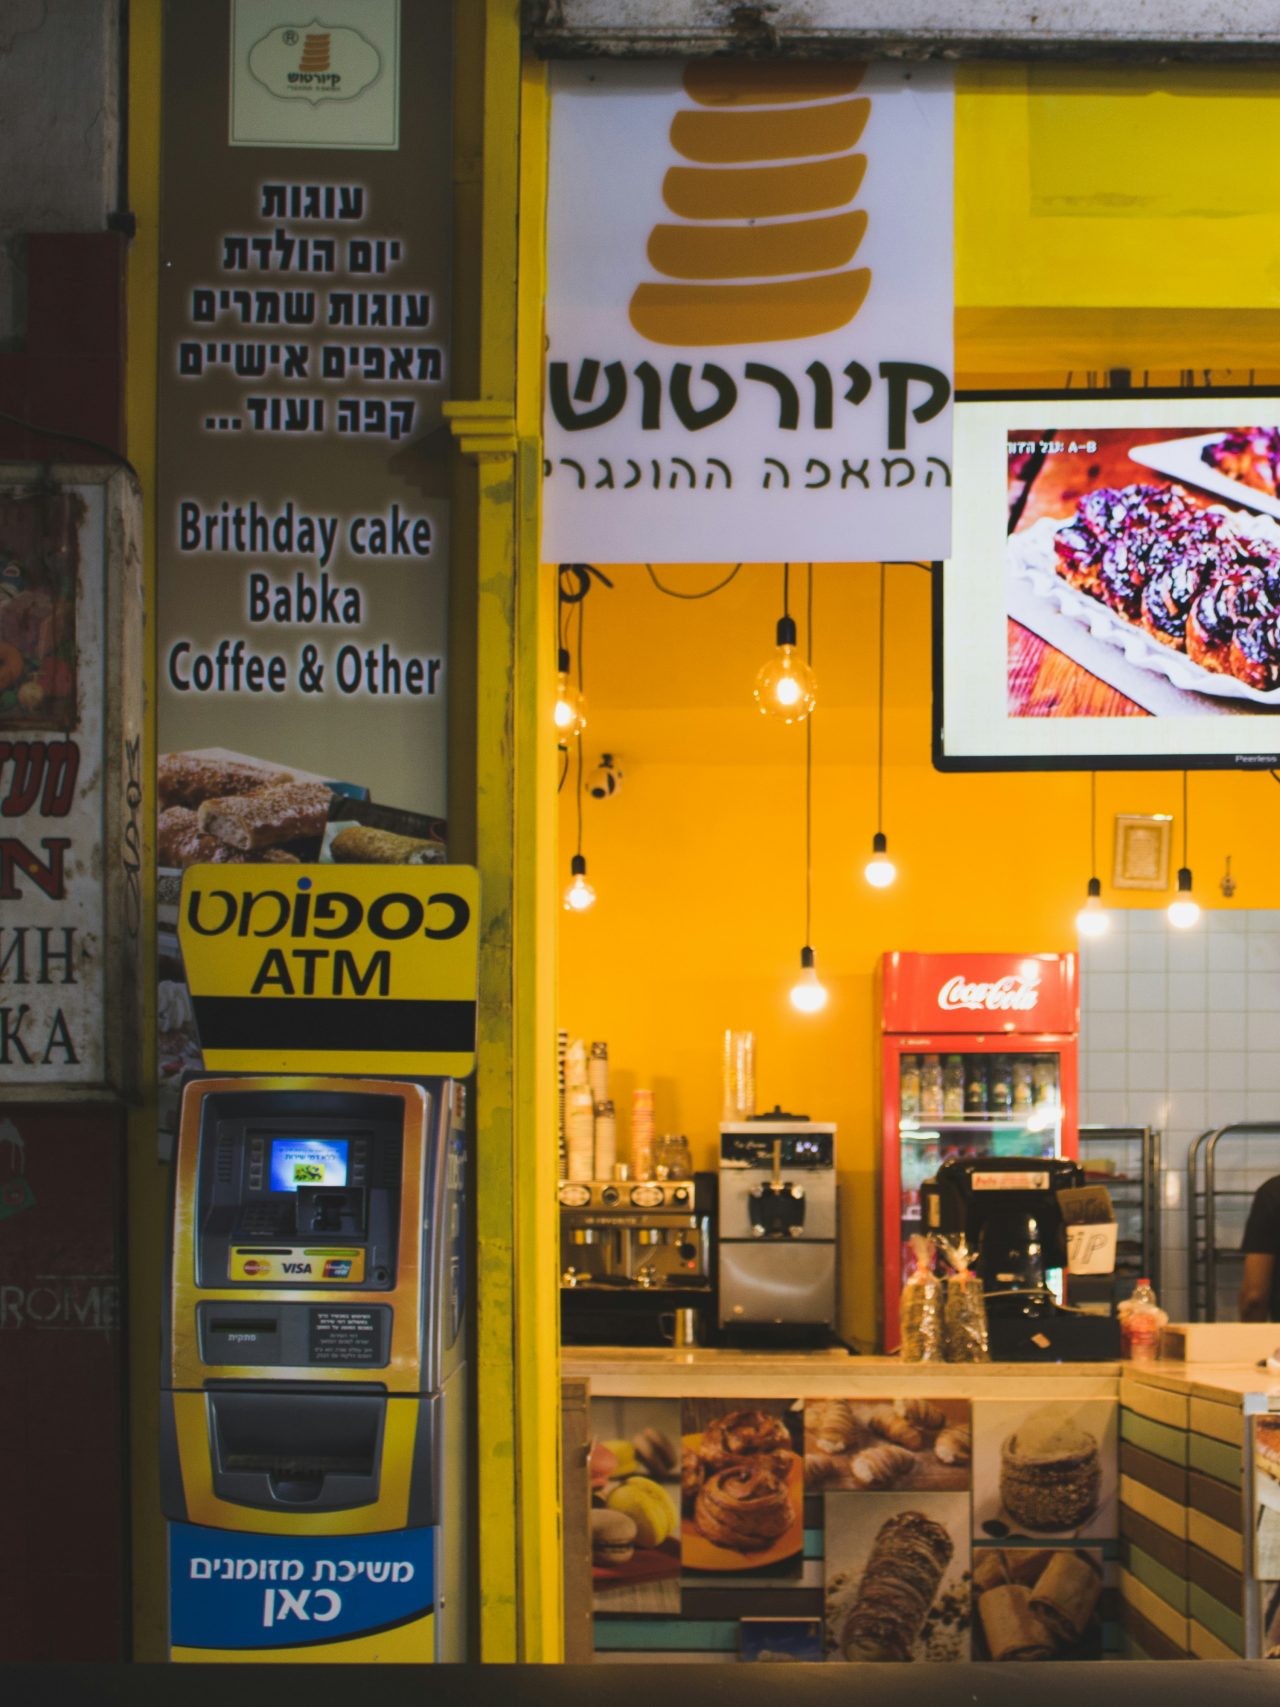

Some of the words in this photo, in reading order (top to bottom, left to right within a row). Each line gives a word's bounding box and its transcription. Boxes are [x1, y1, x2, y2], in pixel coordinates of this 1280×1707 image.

[287, 72, 341, 87] קיורטוש
[262, 184, 363, 219] עוגות
[223, 229, 336, 271] הולדת
[348, 238, 401, 272] יום
[192, 289, 315, 324] שמרים
[329, 292, 430, 326] עוגות
[180, 342, 308, 378] אישיים
[322, 345, 442, 380] מאפים
[338, 401, 414, 440] קפה
[549, 359, 951, 450] קיורטוש
[543, 456, 733, 490] ההונגרי
[762, 457, 952, 489] המאפה
[180, 502, 338, 566] Brithday
[350, 504, 432, 555] cake
[250, 573, 361, 624] Babka
[169, 641, 287, 693] Coffee
[299, 643, 324, 694] &
[336, 644, 441, 694] Other
[187, 877, 471, 941] כספומט
[250, 948, 391, 997] ATM
[938, 975, 1041, 1010] Coca-Cola
[282, 1262, 312, 1274] VISA
[189, 1557, 304, 1581] מזומנים
[313, 1558, 414, 1583] משיכת
[262, 1588, 342, 1628] כאן
